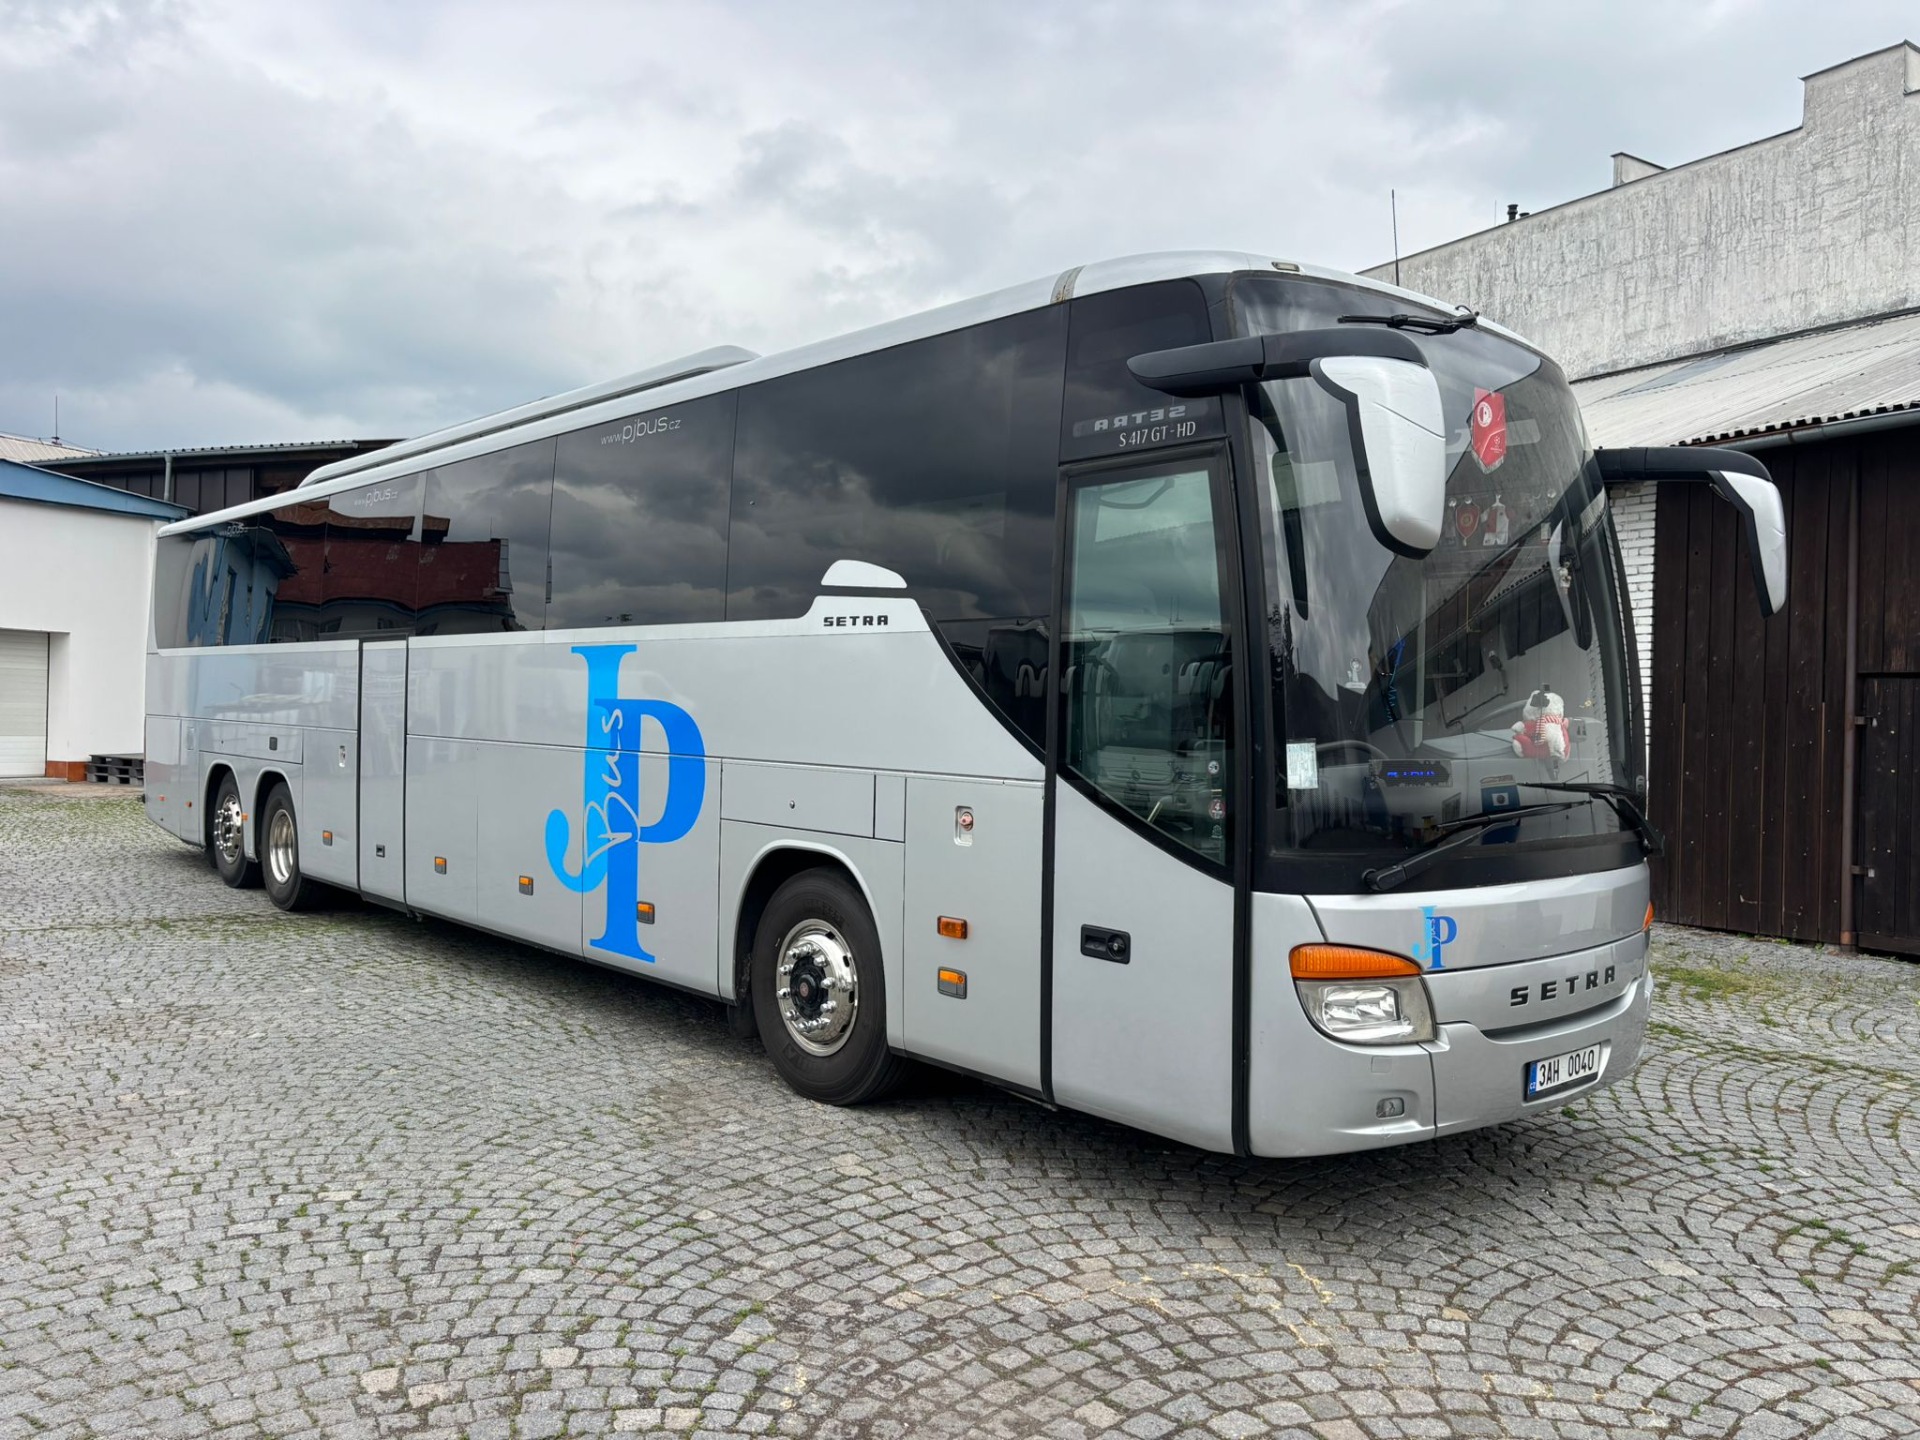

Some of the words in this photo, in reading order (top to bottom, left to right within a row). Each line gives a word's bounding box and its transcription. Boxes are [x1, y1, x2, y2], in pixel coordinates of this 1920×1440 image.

[1119, 432, 1127, 447] S
[1128, 429, 1149, 446] 417
[823, 615, 889, 627] SETRA
[1510, 965, 1615, 1007] SETRA
[1539, 1059, 1560, 1086] 3AH
[1568, 1049, 1594, 1077] 0040
